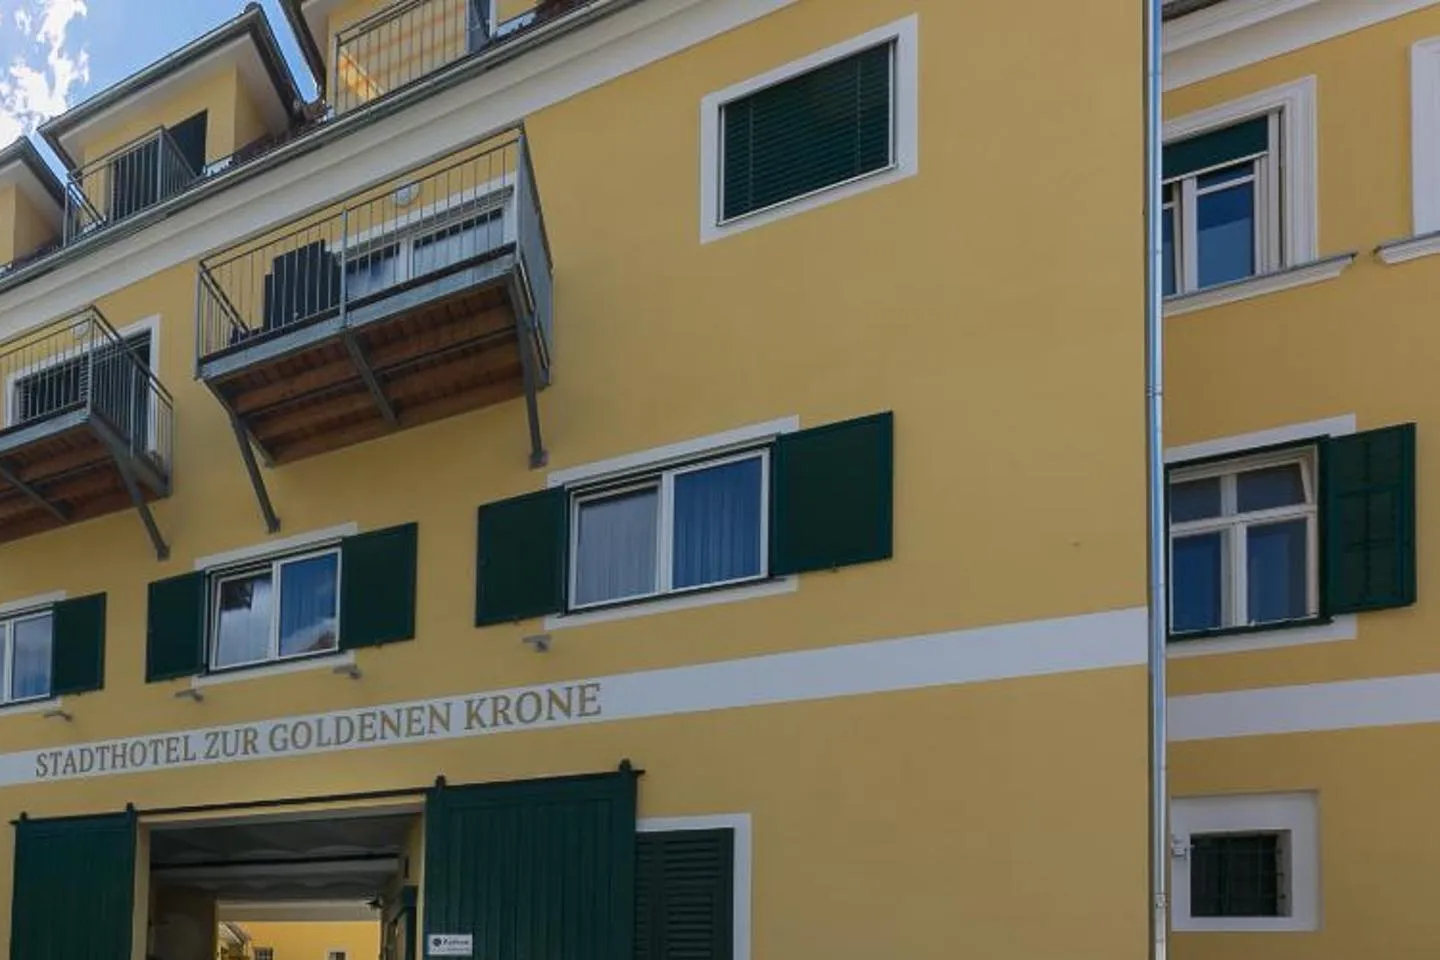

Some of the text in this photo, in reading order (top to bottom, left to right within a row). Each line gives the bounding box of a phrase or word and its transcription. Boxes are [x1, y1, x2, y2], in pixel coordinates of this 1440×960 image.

[35, 683, 602, 777] STADTHOTEL ZUR GOLDENEN KRONE
